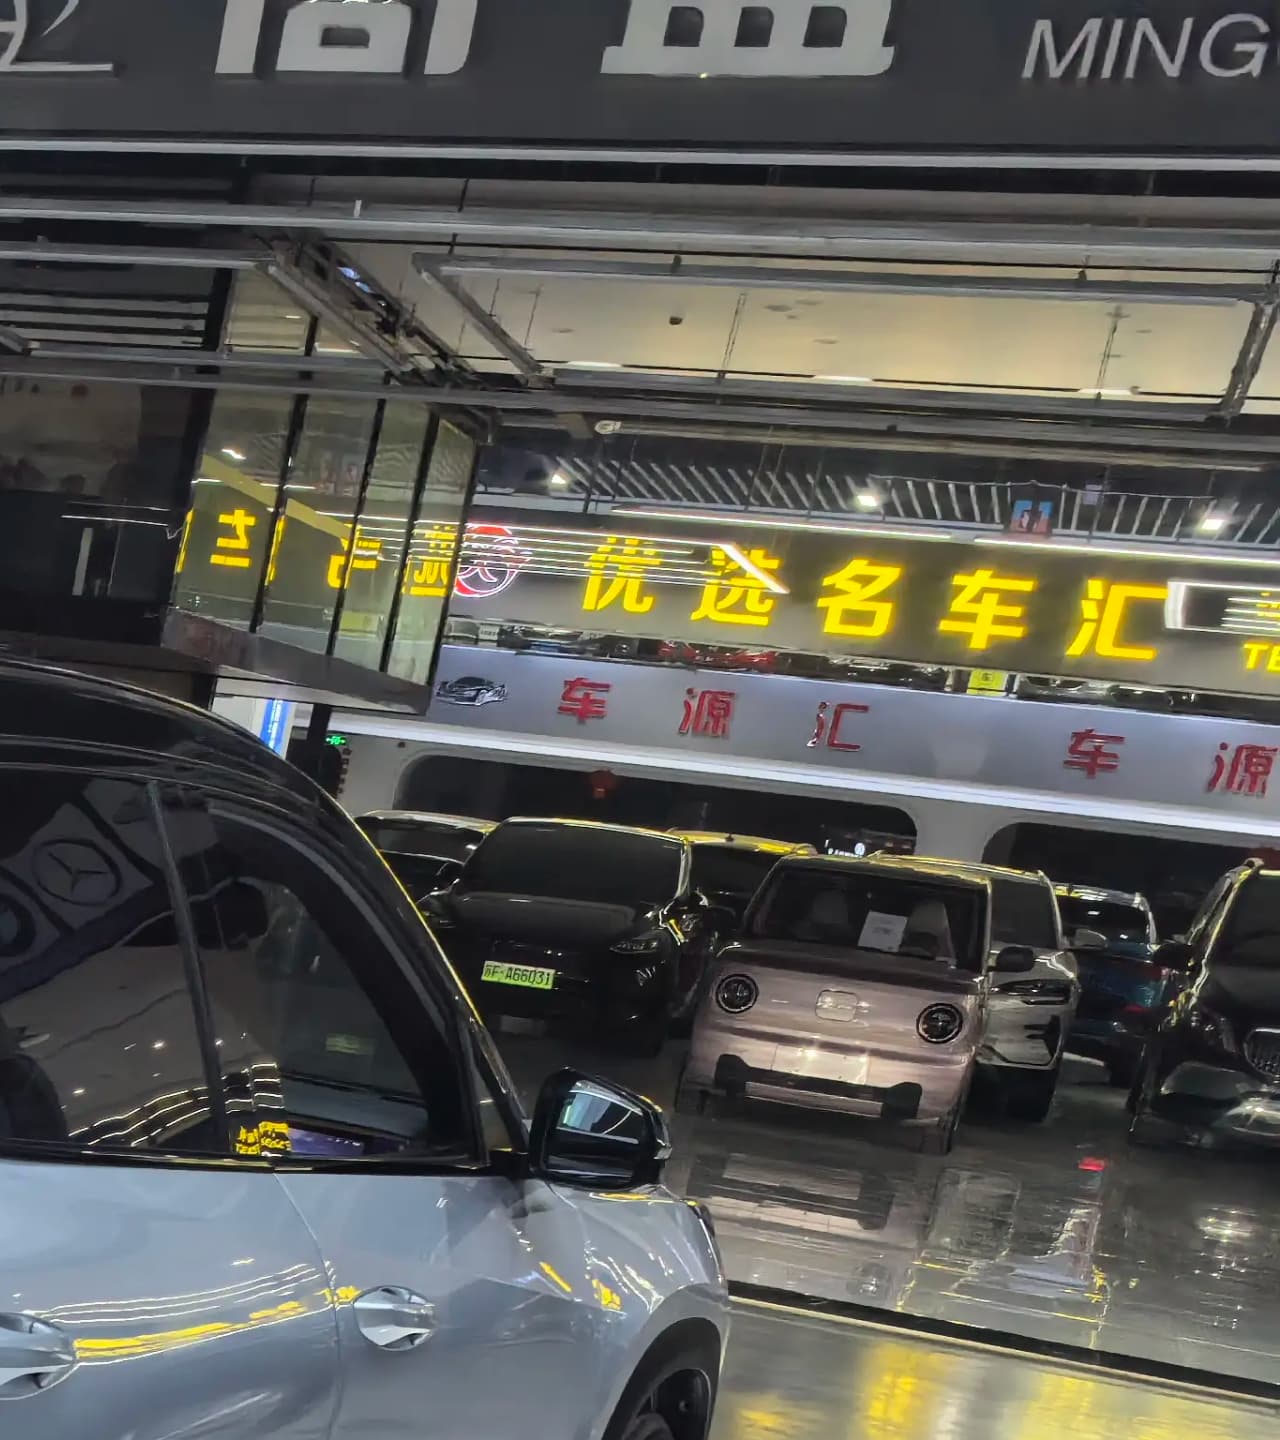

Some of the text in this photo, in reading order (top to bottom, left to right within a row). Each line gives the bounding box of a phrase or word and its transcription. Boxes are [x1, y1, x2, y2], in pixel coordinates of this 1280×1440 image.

[1023, 13, 1280, 79] MING
[580, 534, 1169, 662] 优选名车汇
[557, 676, 871, 752] 车源汇
